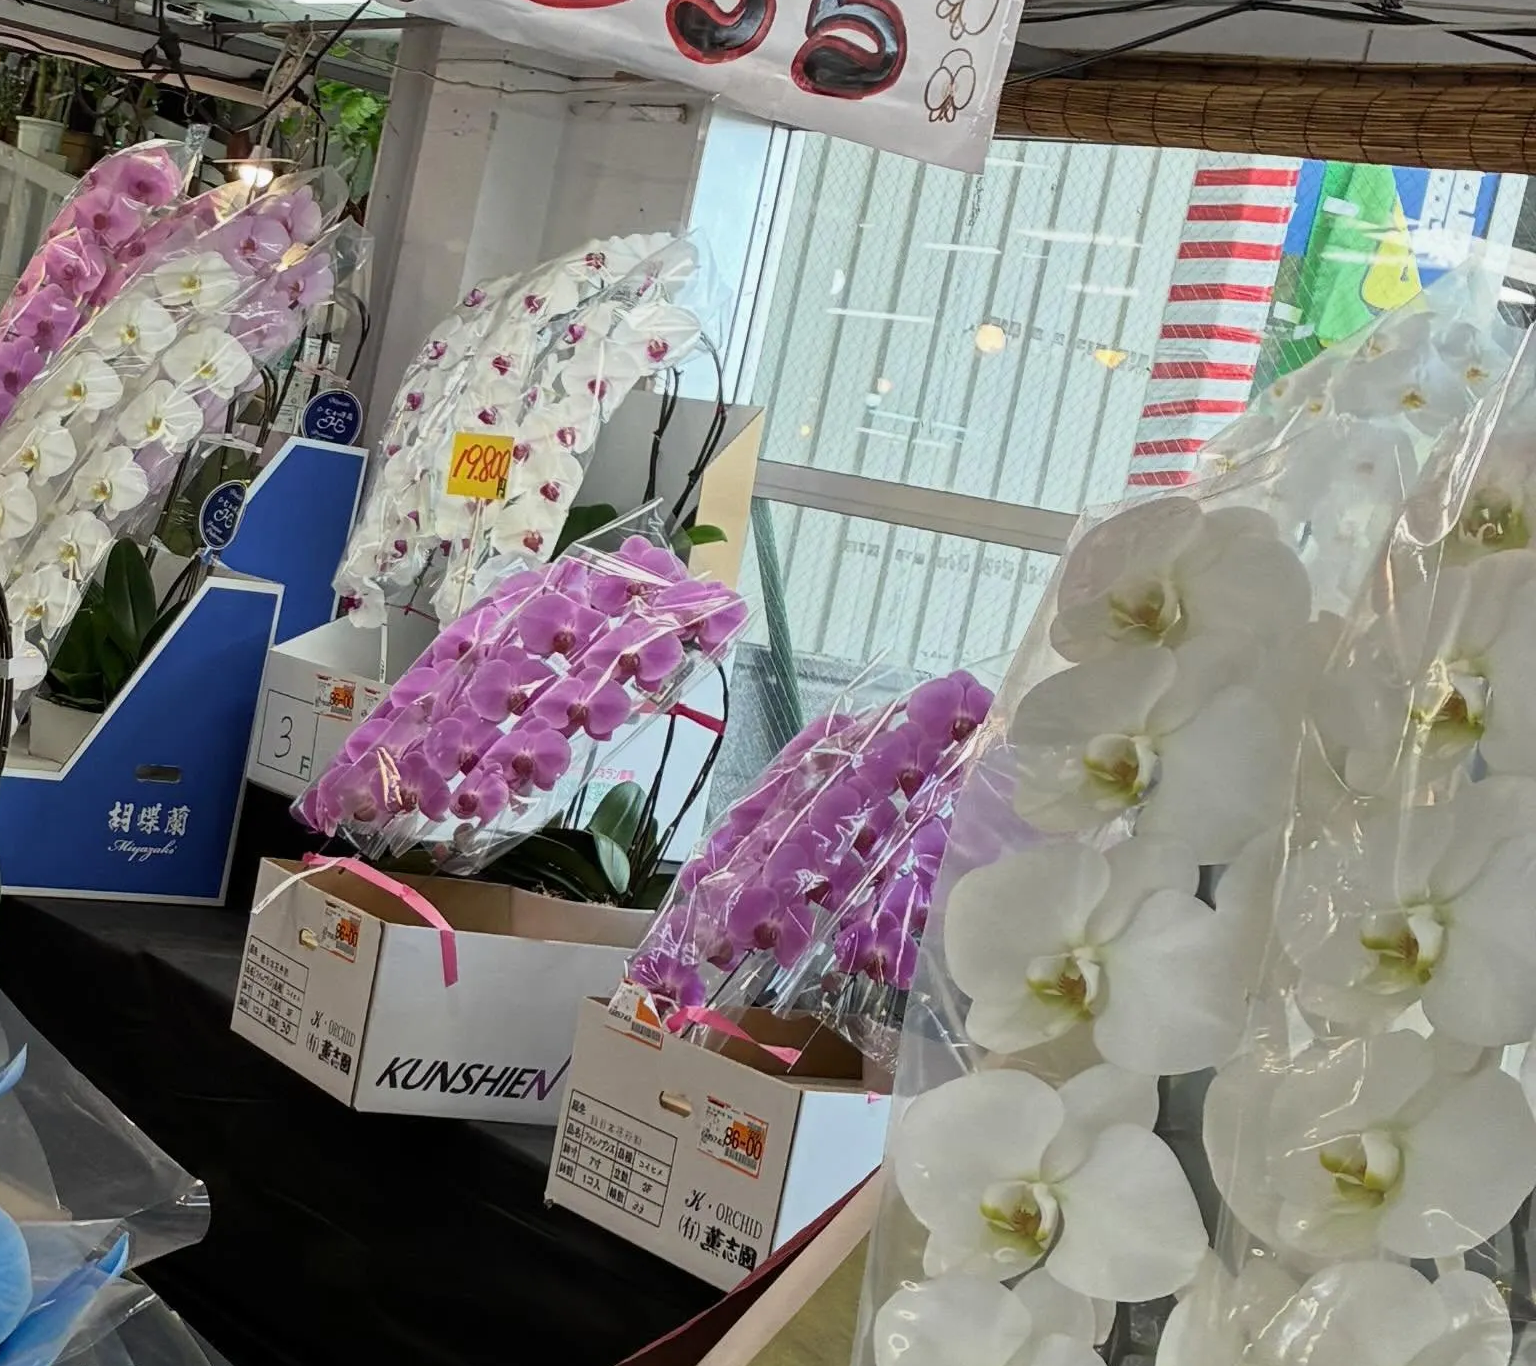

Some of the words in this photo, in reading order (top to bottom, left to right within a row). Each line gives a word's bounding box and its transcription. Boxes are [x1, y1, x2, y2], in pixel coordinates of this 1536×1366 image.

[274, 716, 293, 758] 3
[299, 755, 311, 775] F
[108, 801, 191, 836] 胡蝶蘭
[107, 838, 178, 862] Miyazaki
[375, 1054, 573, 1102] KUNSHIEN
[723, 1126, 763, 1161] 86-00
